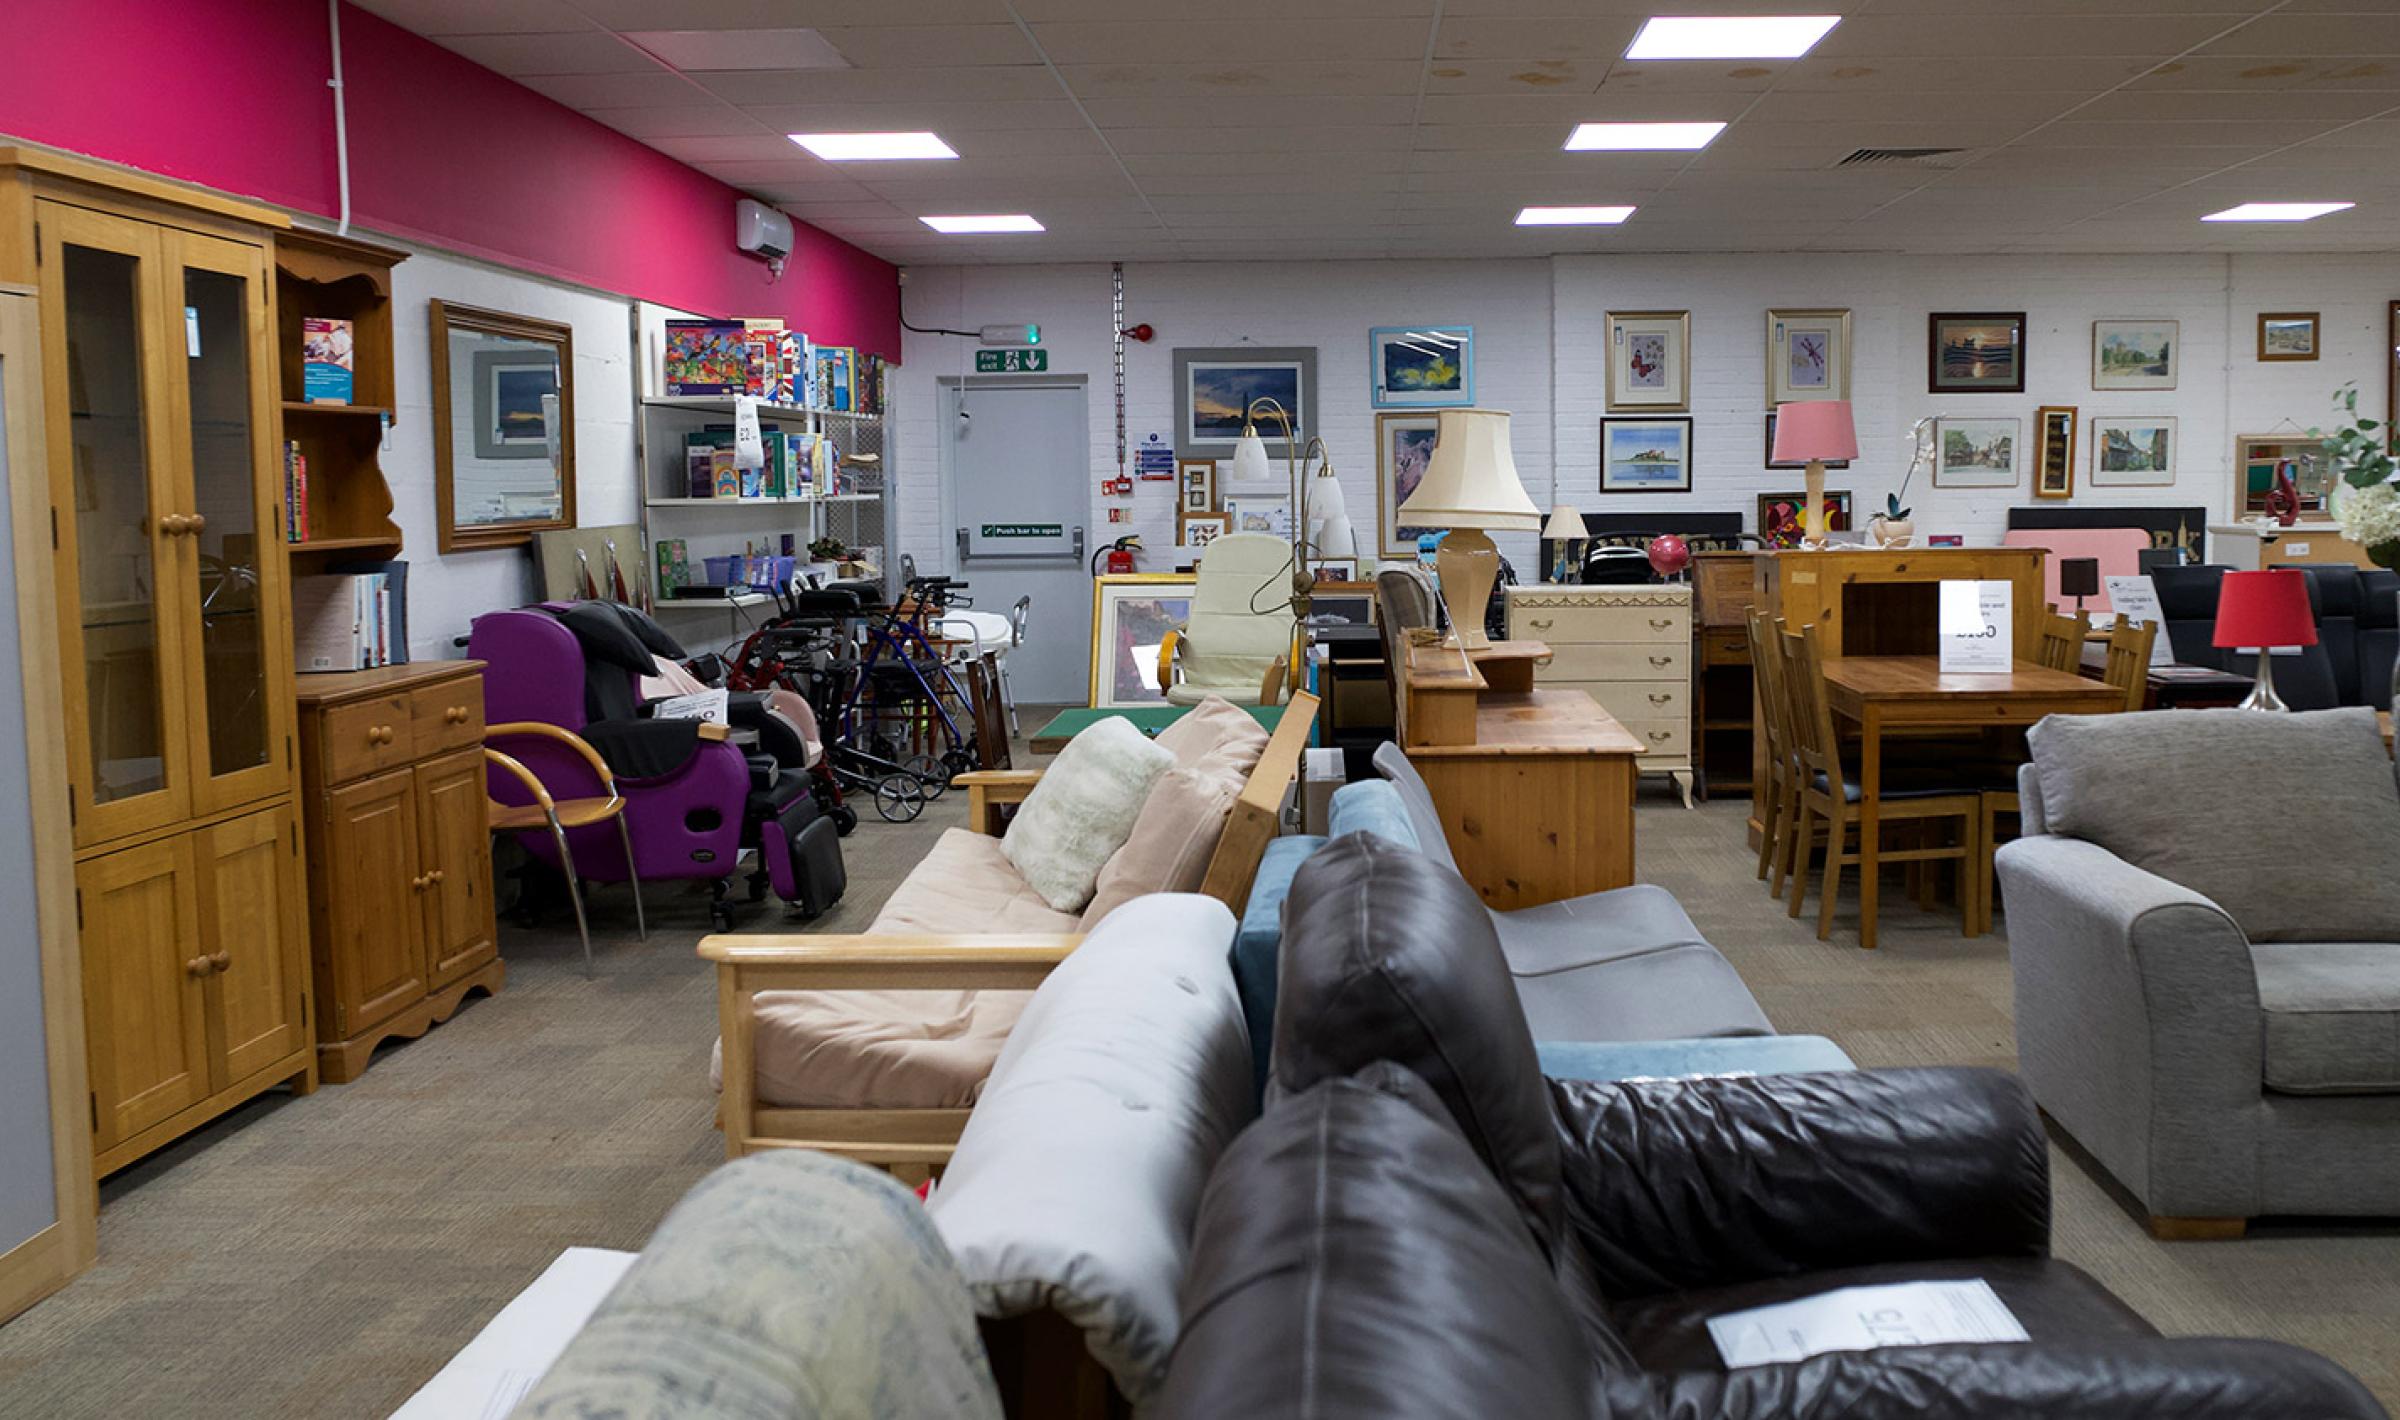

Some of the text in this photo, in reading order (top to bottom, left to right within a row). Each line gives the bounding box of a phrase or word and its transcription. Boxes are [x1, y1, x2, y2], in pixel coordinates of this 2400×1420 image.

[980, 351, 998, 360] Fire
[980, 362, 998, 370] exit
[996, 527, 1060, 536] Push bar to open
